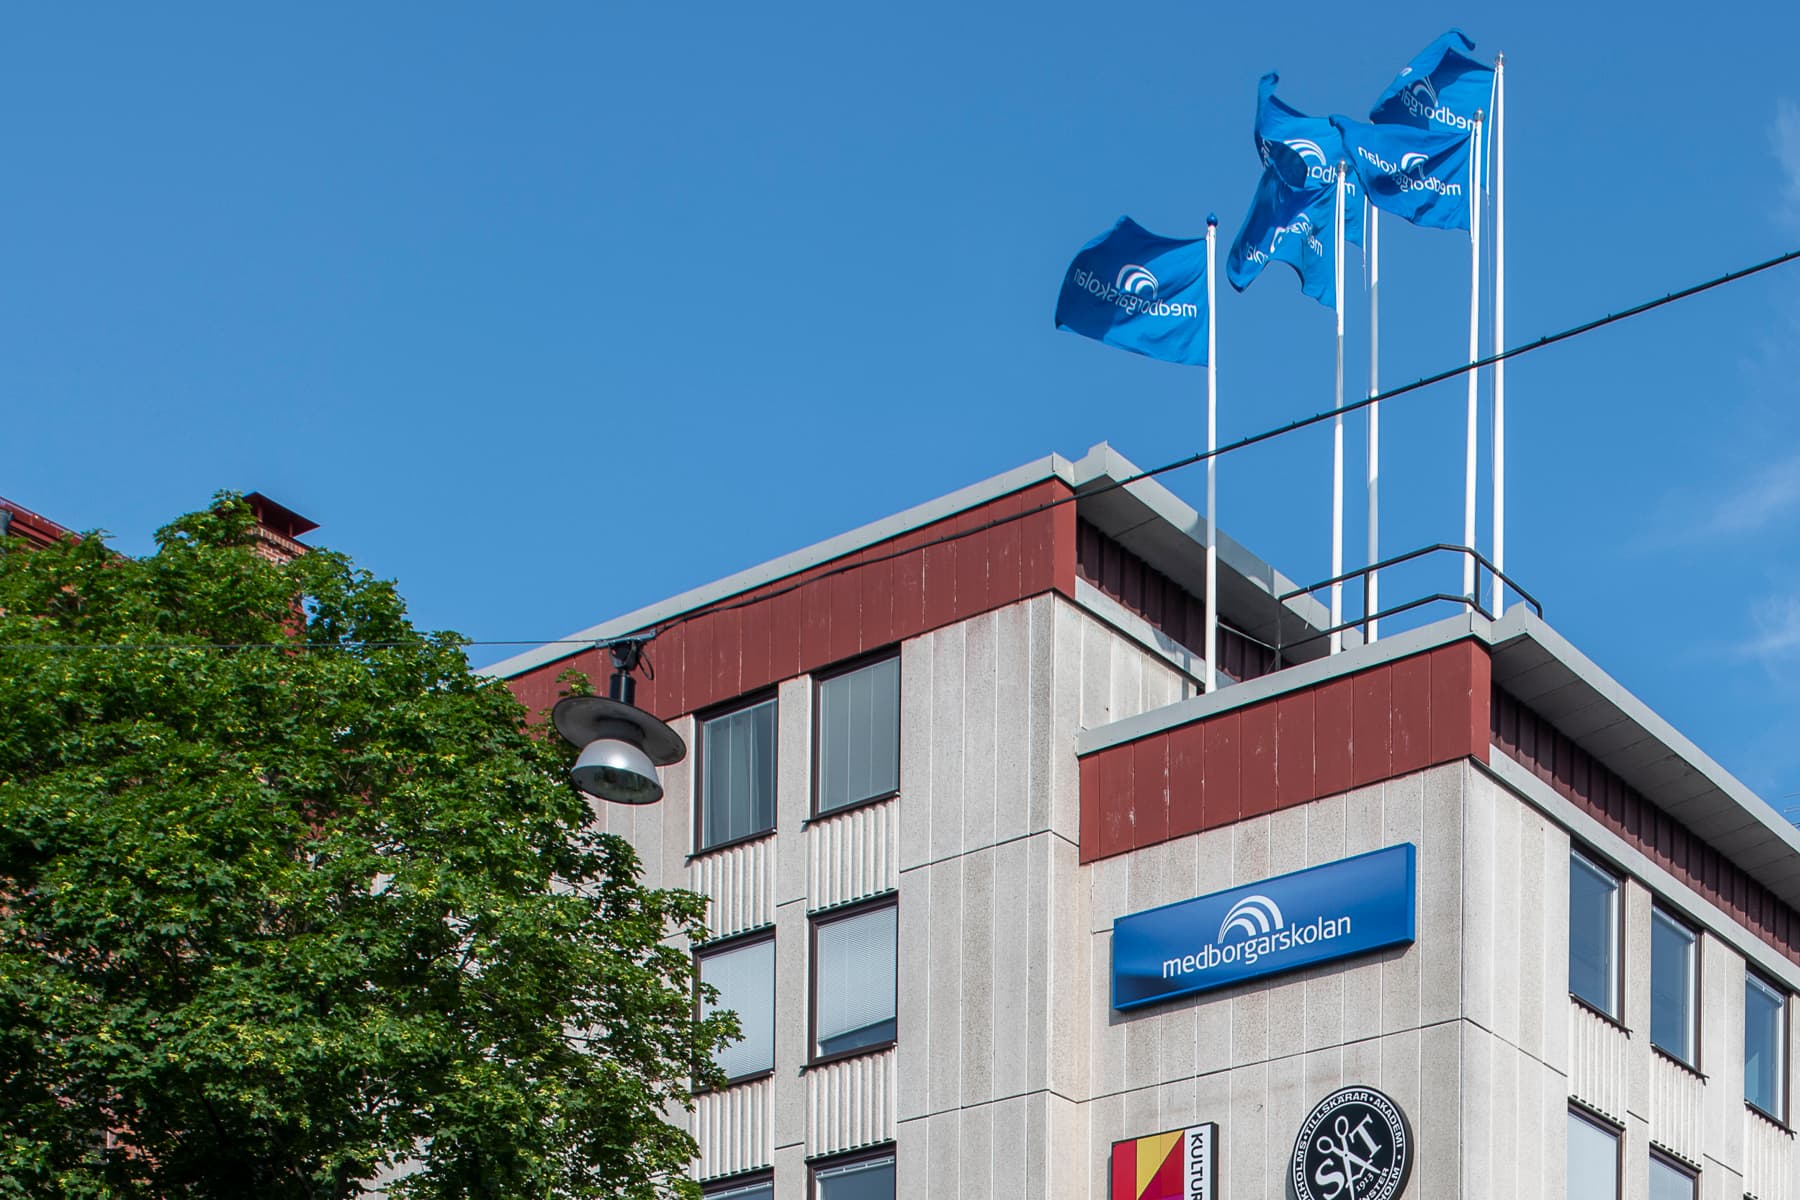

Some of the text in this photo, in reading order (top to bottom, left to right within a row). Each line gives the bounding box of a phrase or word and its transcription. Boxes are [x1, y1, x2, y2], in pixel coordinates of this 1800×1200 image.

[1162, 914, 1351, 979] medborgarskolan
[1307, 1092, 1369, 1137] TILLSKÄRAR
[1372, 1098, 1404, 1149] AKADEMI
[1356, 1172, 1374, 1193] 1913
